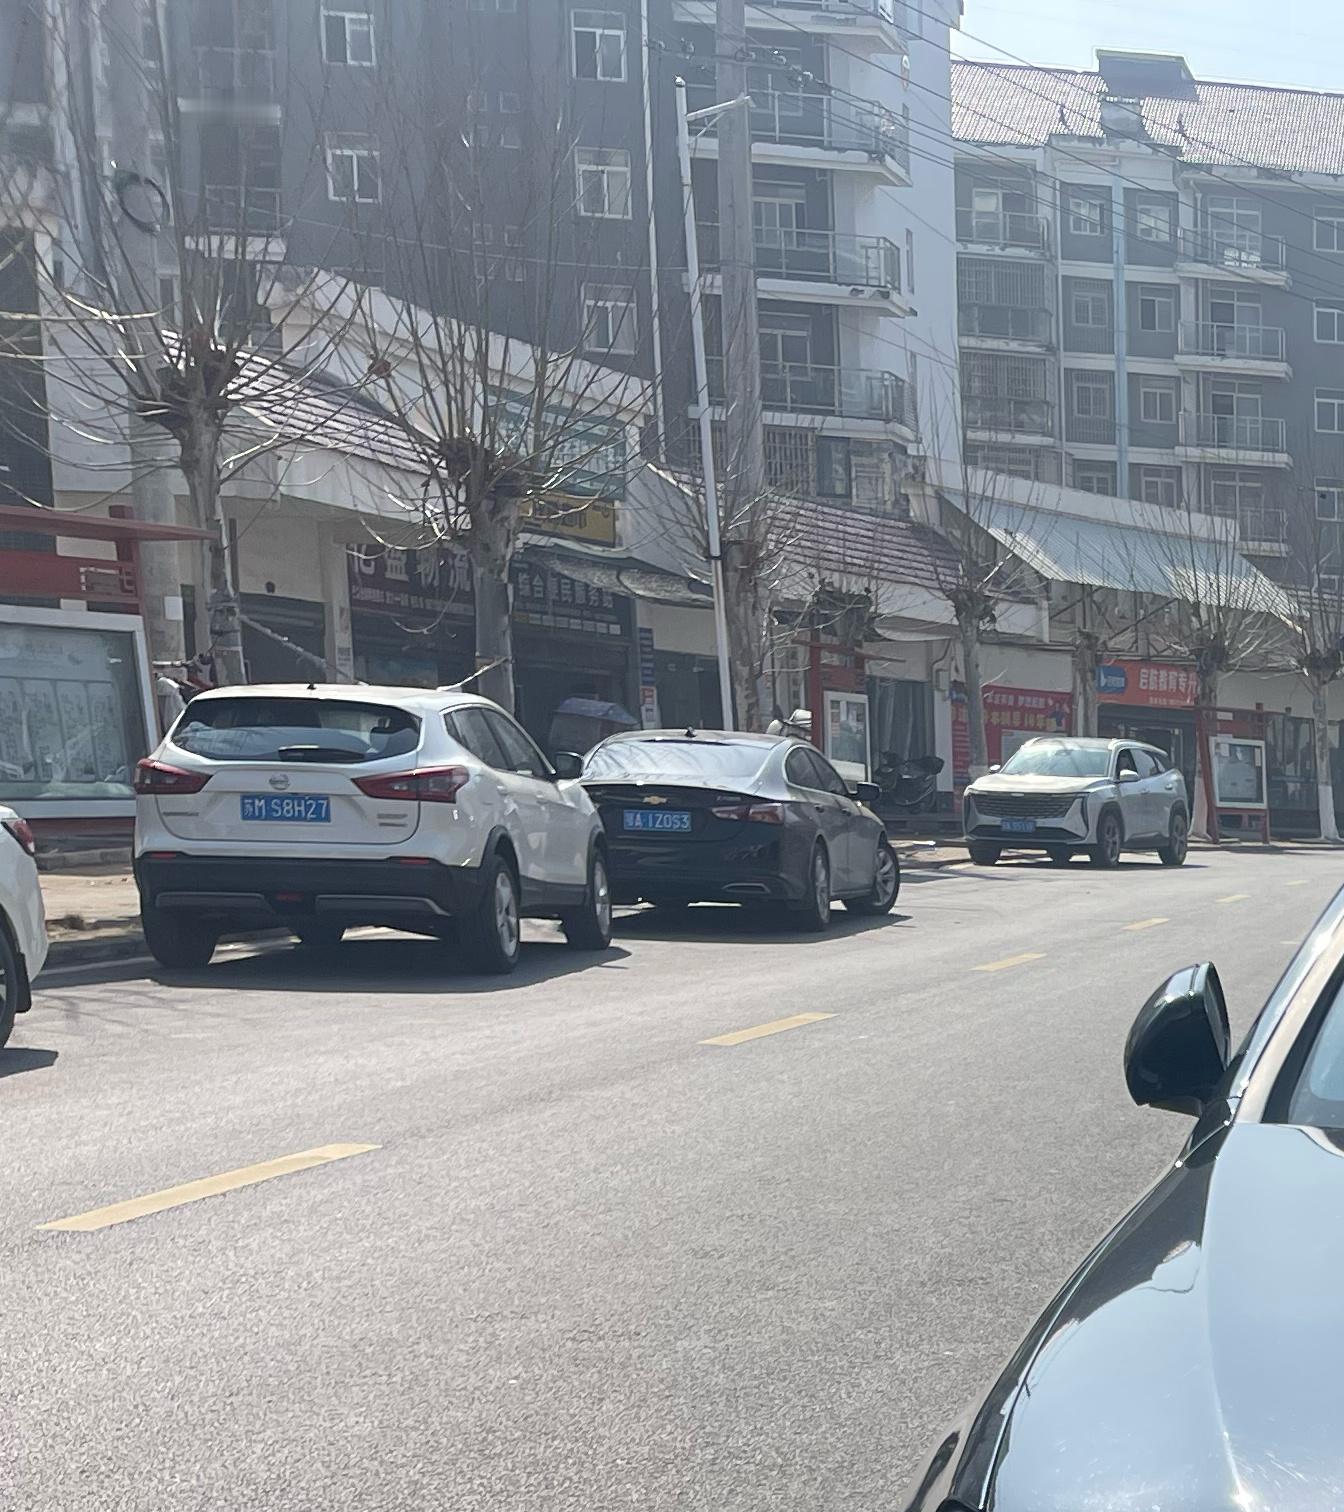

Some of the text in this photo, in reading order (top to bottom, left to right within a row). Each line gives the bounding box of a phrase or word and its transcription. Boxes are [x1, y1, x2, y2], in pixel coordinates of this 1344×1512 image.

[1139, 667, 1200, 695] 启航教育专升
